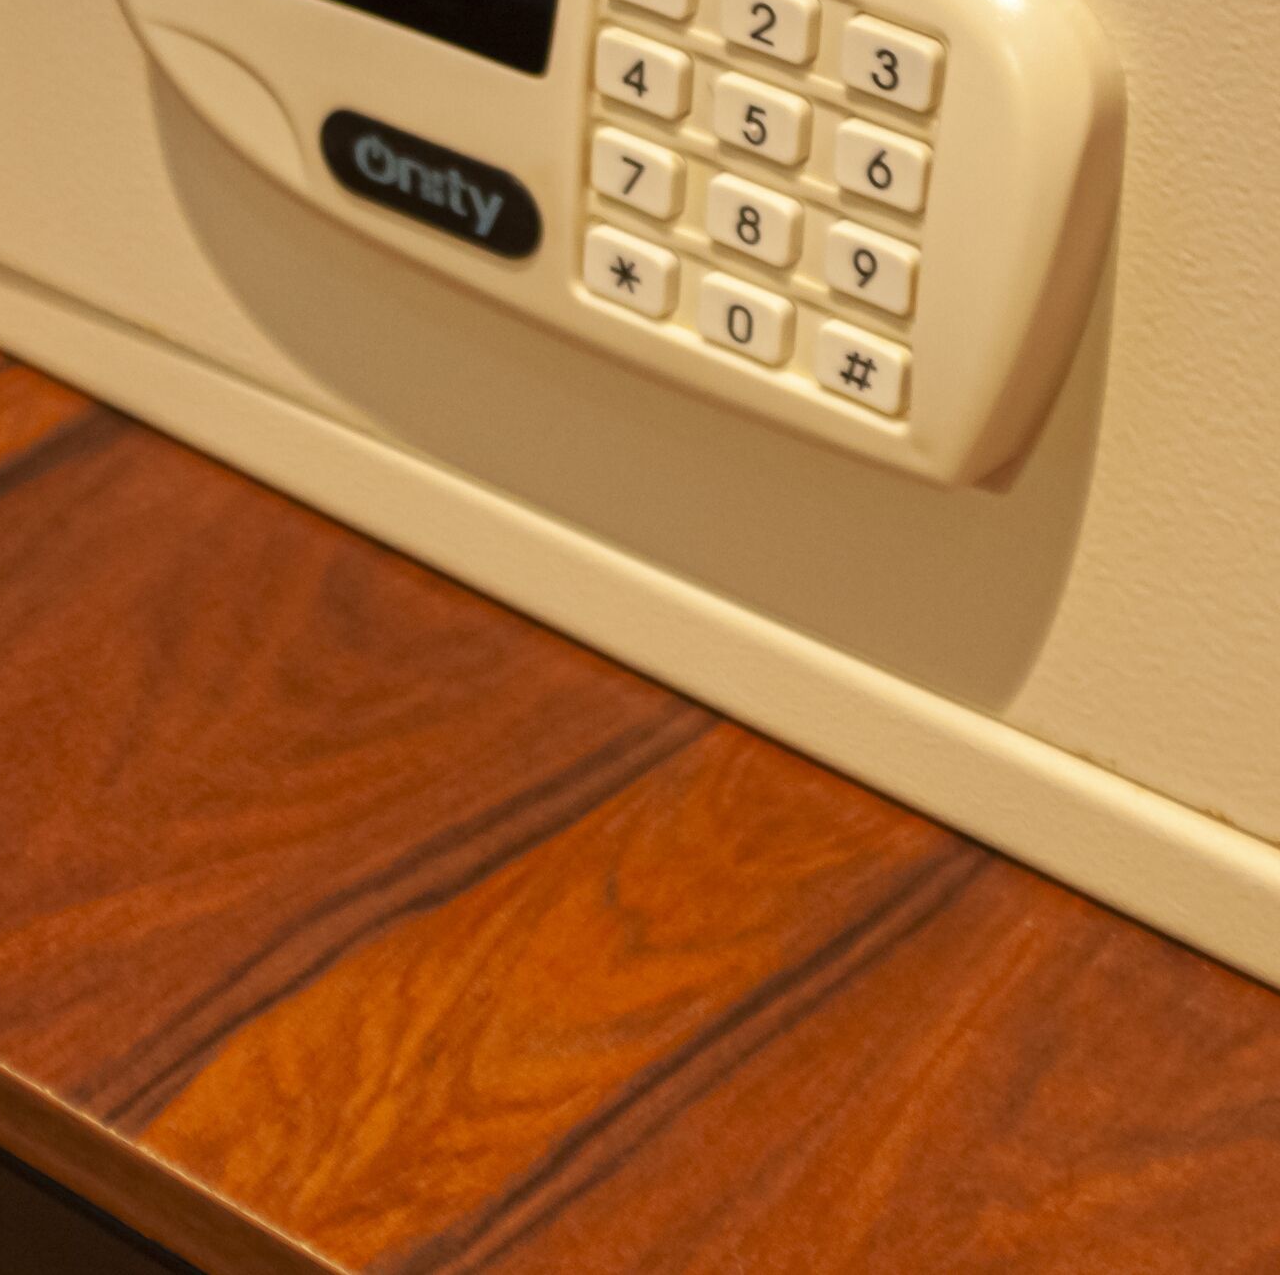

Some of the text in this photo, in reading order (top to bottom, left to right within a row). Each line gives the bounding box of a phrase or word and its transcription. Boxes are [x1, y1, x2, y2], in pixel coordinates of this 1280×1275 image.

[749, 2, 778, 46] 2
[870, 48, 899, 92] 3
[622, 59, 893, 191] 4 5 6
[353, 133, 504, 238] Onity
[621, 155, 878, 288] 7 8 9
[726, 303, 754, 345] 0
[839, 351, 877, 391] #
